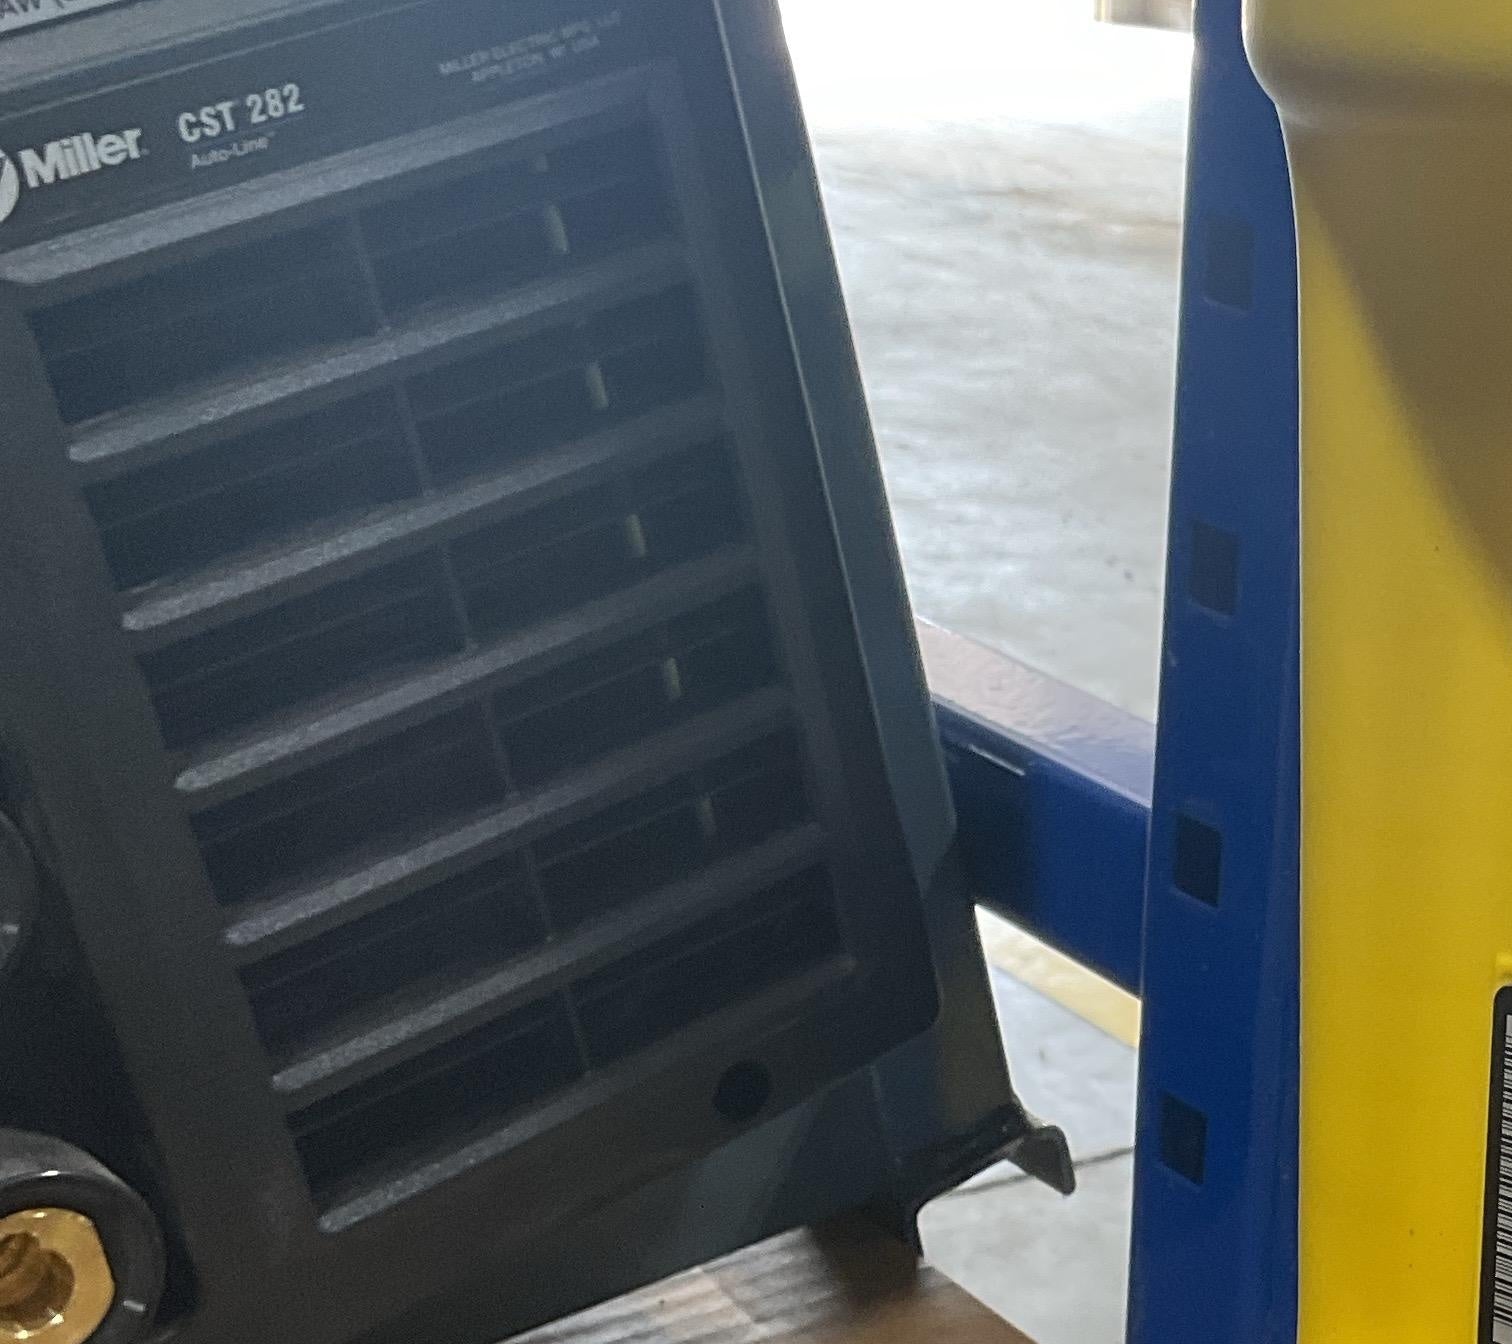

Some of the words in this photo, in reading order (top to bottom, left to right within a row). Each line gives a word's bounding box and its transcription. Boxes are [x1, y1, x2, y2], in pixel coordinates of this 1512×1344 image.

[178, 100, 237, 143] CST
[245, 82, 305, 125] 282
[18, 127, 143, 189] Miller
